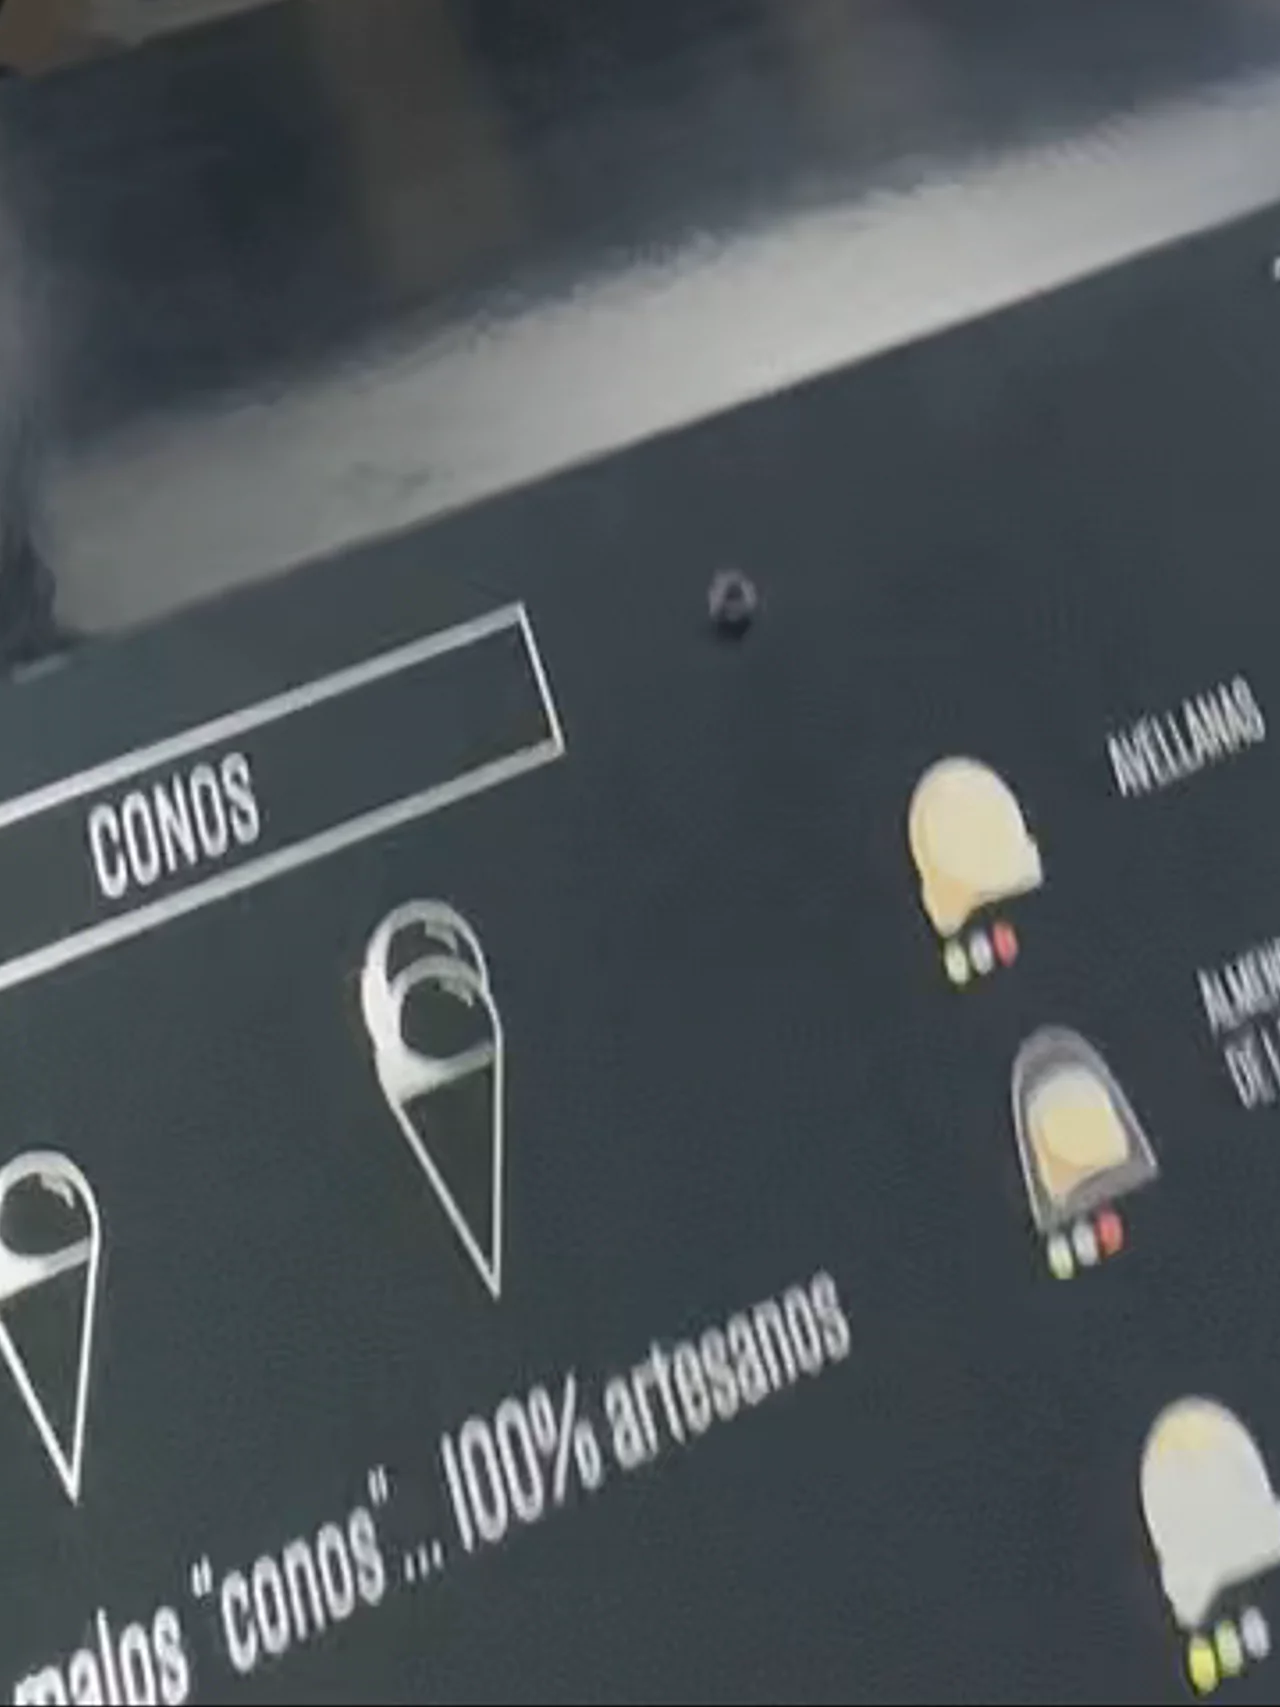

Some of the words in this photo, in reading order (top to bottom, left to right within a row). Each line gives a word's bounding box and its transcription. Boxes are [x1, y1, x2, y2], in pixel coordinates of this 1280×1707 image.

[1108, 674, 1266, 798] AVELLANAS
[86, 751, 261, 900] CONOS
[1223, 1033, 1277, 1109] DE
[440, 1373, 606, 1555] 100%
[604, 1269, 853, 1471] artesanos
